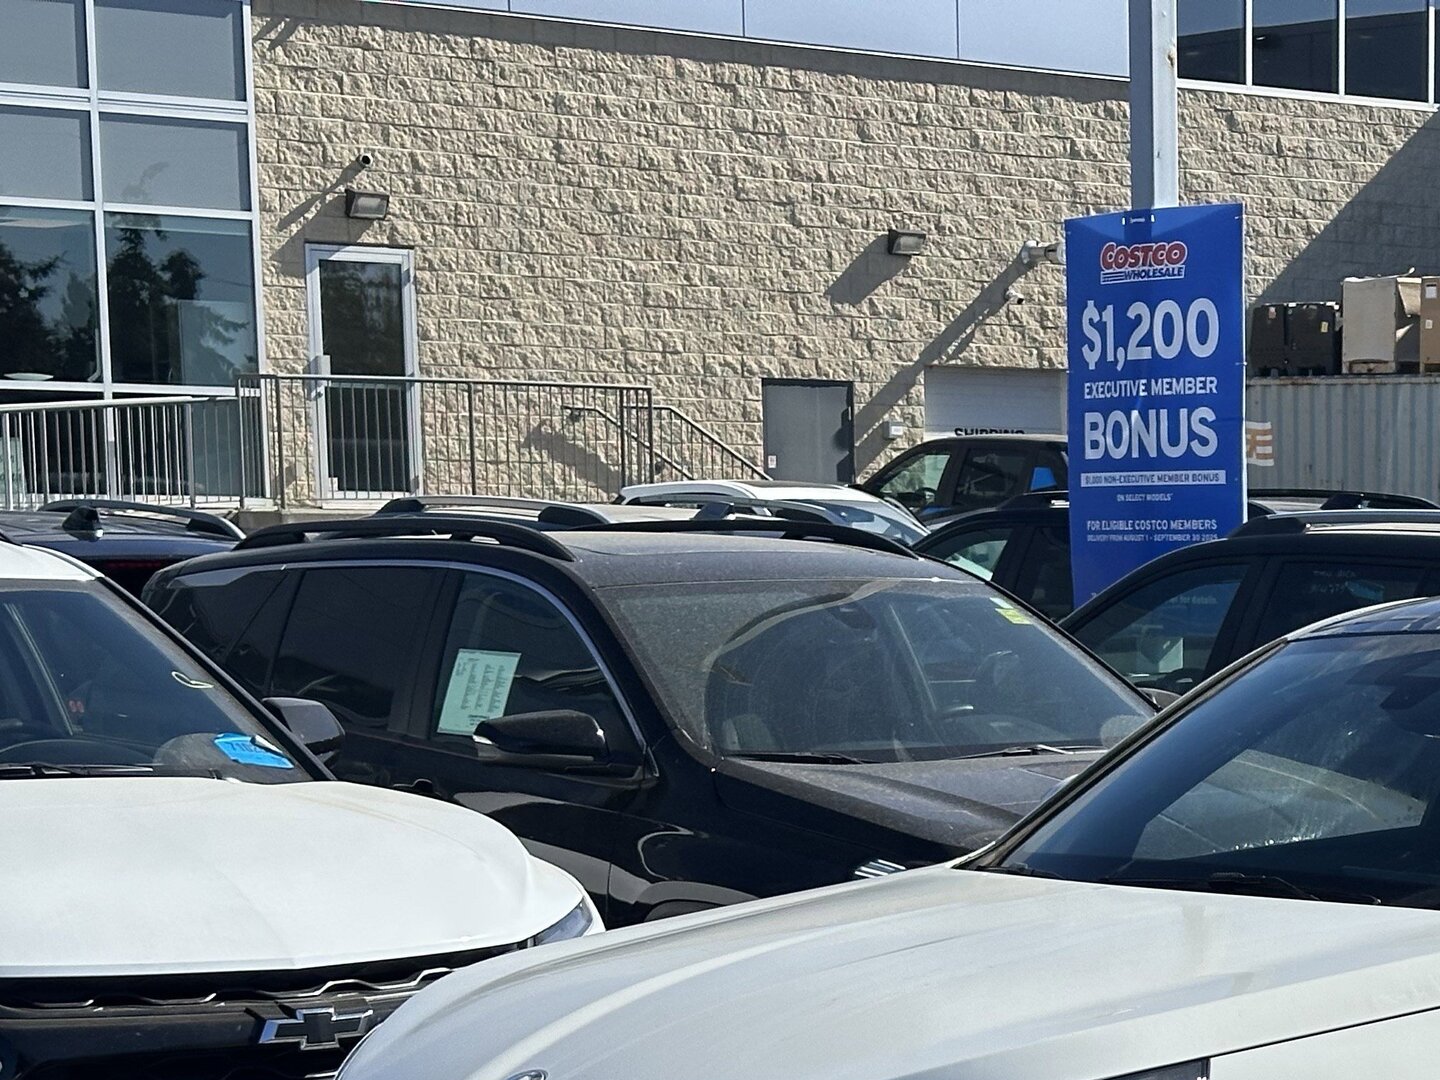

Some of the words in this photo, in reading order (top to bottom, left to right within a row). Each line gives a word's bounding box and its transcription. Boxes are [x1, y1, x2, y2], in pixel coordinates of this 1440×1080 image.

[1101, 241, 1188, 271] COSTCO
[1124, 266, 1184, 281] WHOLESALE
[1081, 298, 1219, 371] $1,200
[1084, 379, 1147, 399] EXECUTIVE
[1150, 376, 1218, 396] MEMBER
[1084, 406, 1219, 461] BONUS
[1103, 473, 1155, 485] NON-EXECUTIVE
[1157, 473, 1190, 484] MEMBER
[1191, 472, 1220, 483] BONUS
[1126, 493, 1146, 502] SELECT
[1087, 520, 1101, 531] FOR
[1102, 520, 1134, 531] ELIGIBLE
[1135, 519, 1169, 530] COSTCO
[1170, 519, 1217, 530] MEMBERS
[1124, 534, 1145, 542] AUGUST
[1154, 534, 1190, 542] SEPTEMBER
